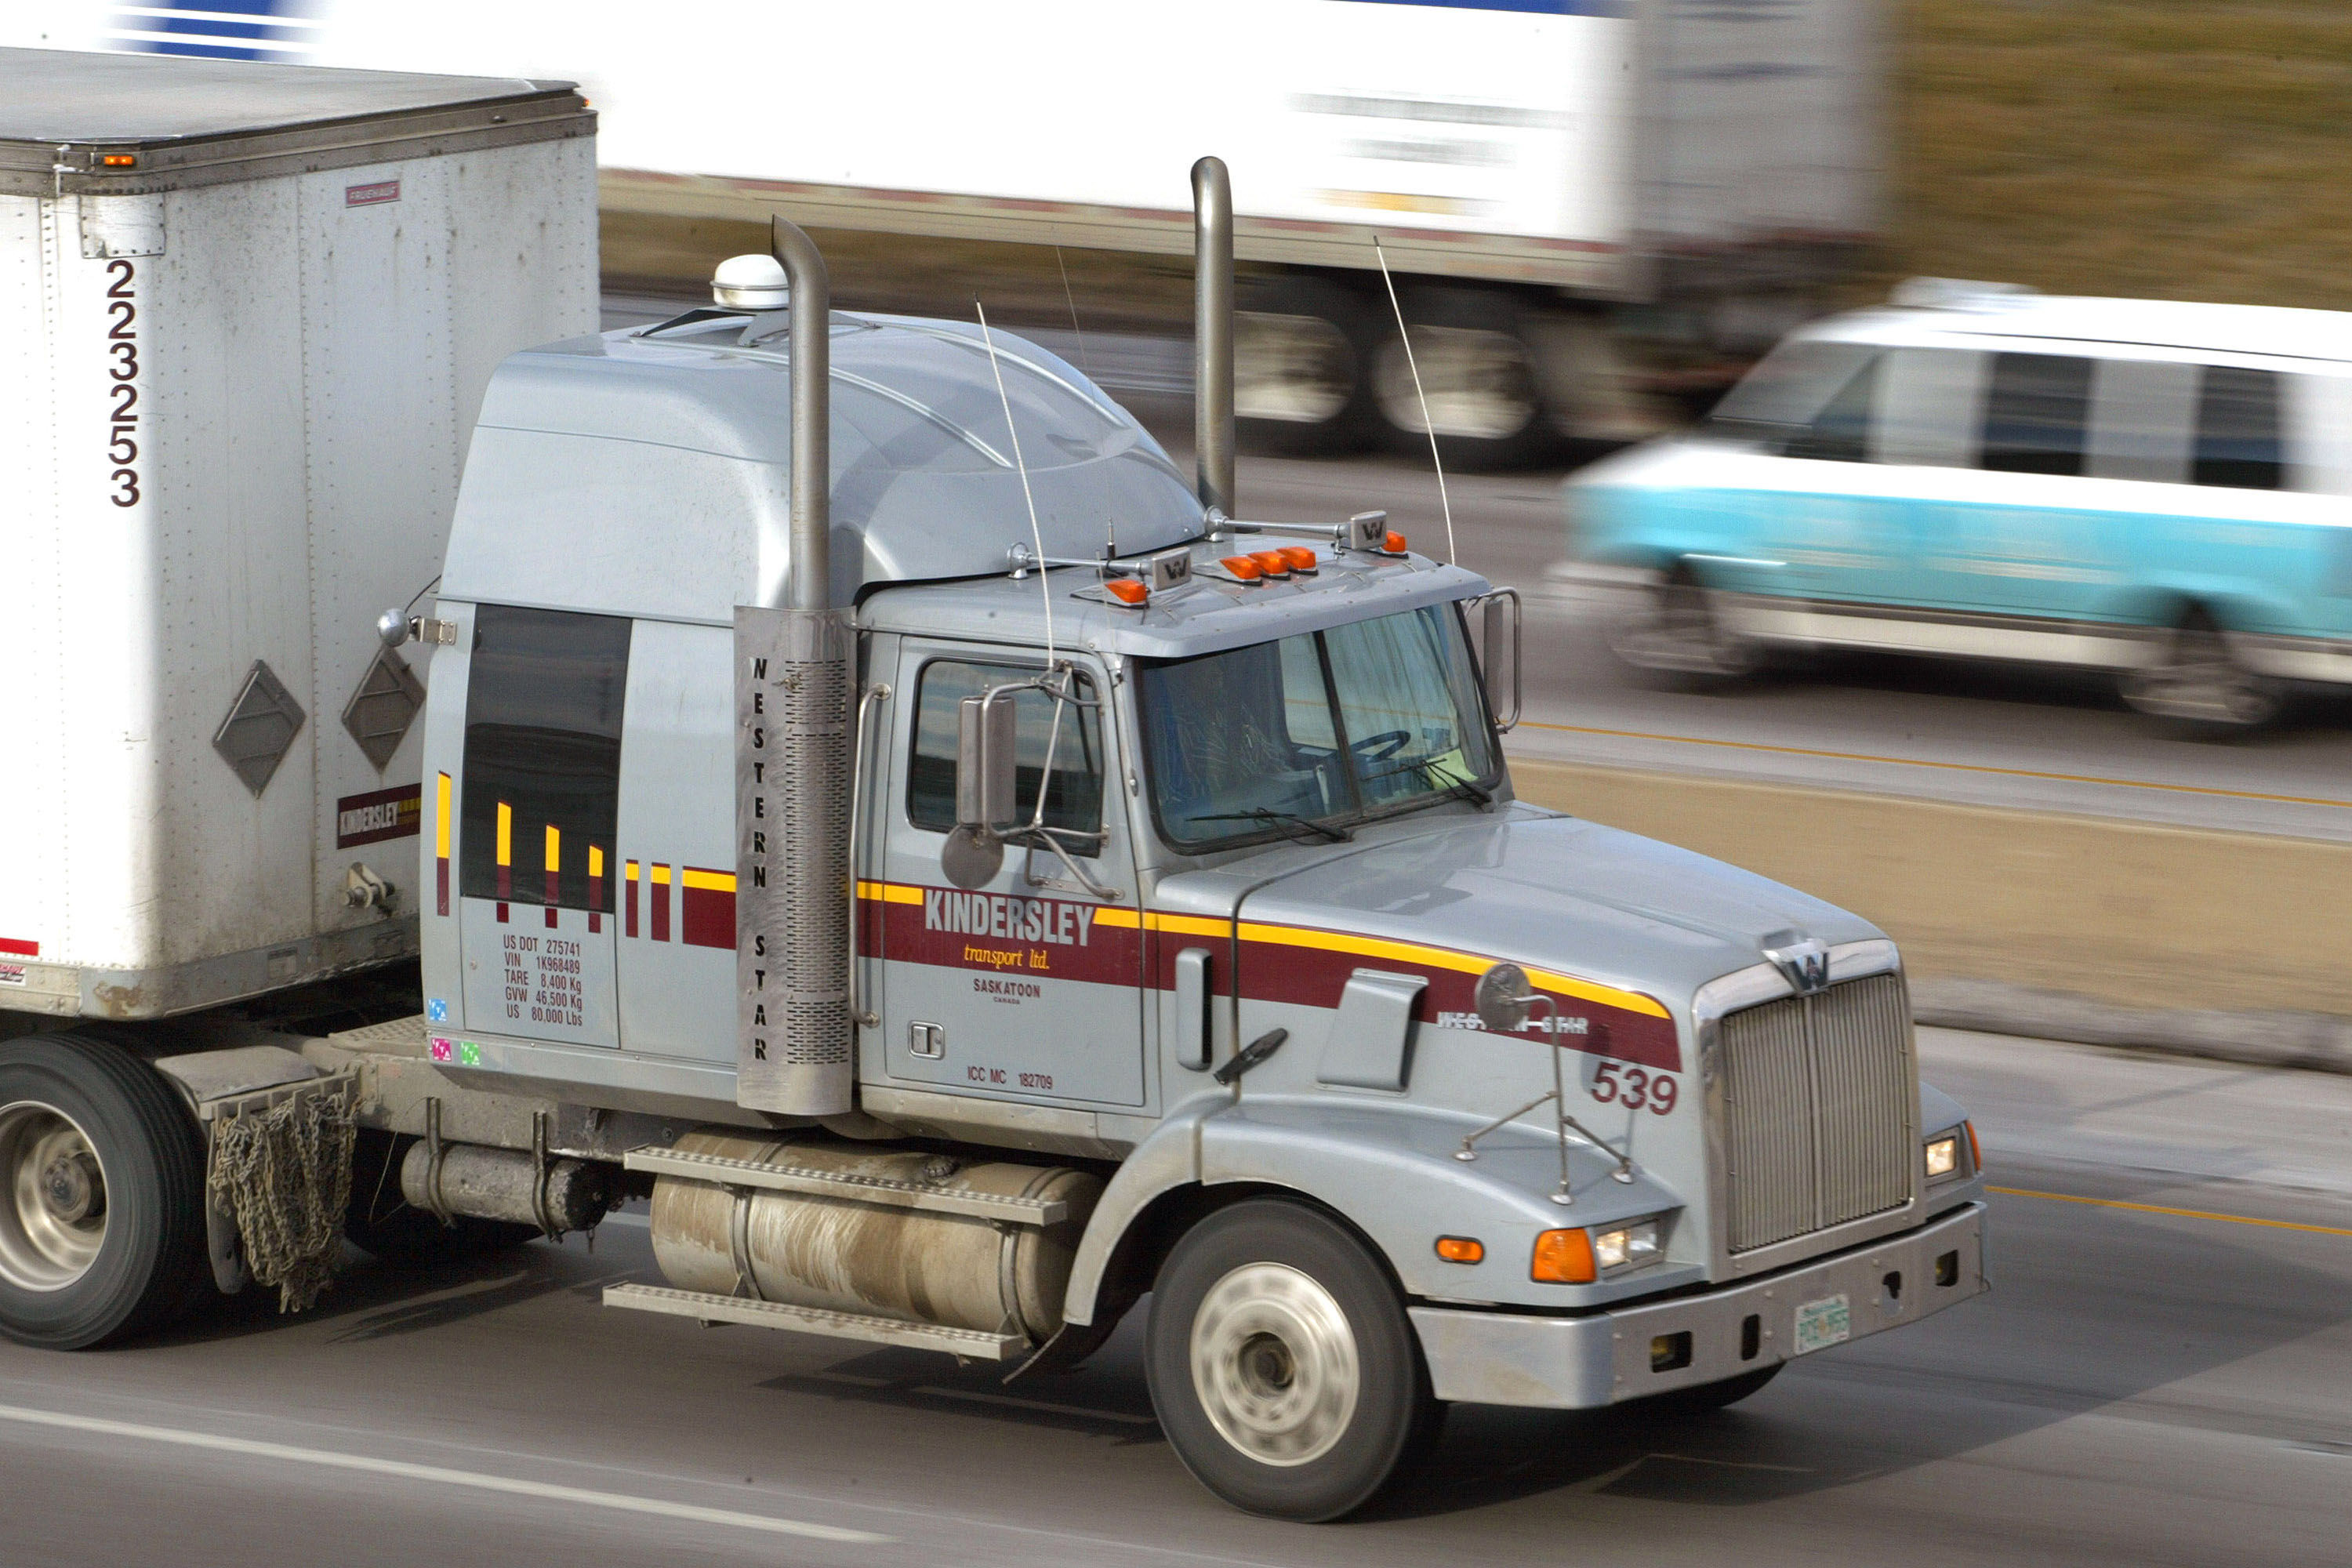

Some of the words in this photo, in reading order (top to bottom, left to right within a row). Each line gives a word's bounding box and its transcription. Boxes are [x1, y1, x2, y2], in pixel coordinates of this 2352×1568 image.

[106, 260, 140, 507] 223253
[1362, 520, 1383, 541] W
[1165, 556, 1187, 580] W
[750, 656, 768, 888] WESTERN
[925, 889, 1096, 947] KINDERSLEY
[503, 934, 517, 950] US
[520, 936, 539, 953] DOT
[546, 939, 580, 957] 275741
[964, 943, 1023, 970] transport
[1029, 948, 1051, 971] ltd.
[504, 951, 521, 967] VIN
[536, 956, 580, 975] 1K968489
[504, 968, 529, 985] TARE
[570, 977, 582, 995] Kg
[973, 978, 1041, 998] SASKATOON
[506, 986, 528, 1003] GVW
[571, 995, 583, 1012] Kg
[754, 935, 767, 1061] STAR
[506, 1004, 521, 1019] US
[566, 1011, 583, 1027] Lbs
[967, 1066, 985, 1082] ICC
[990, 1068, 1007, 1084] MC
[1019, 1073, 1053, 1089] 182709
[1591, 1061, 1679, 1116] 539
